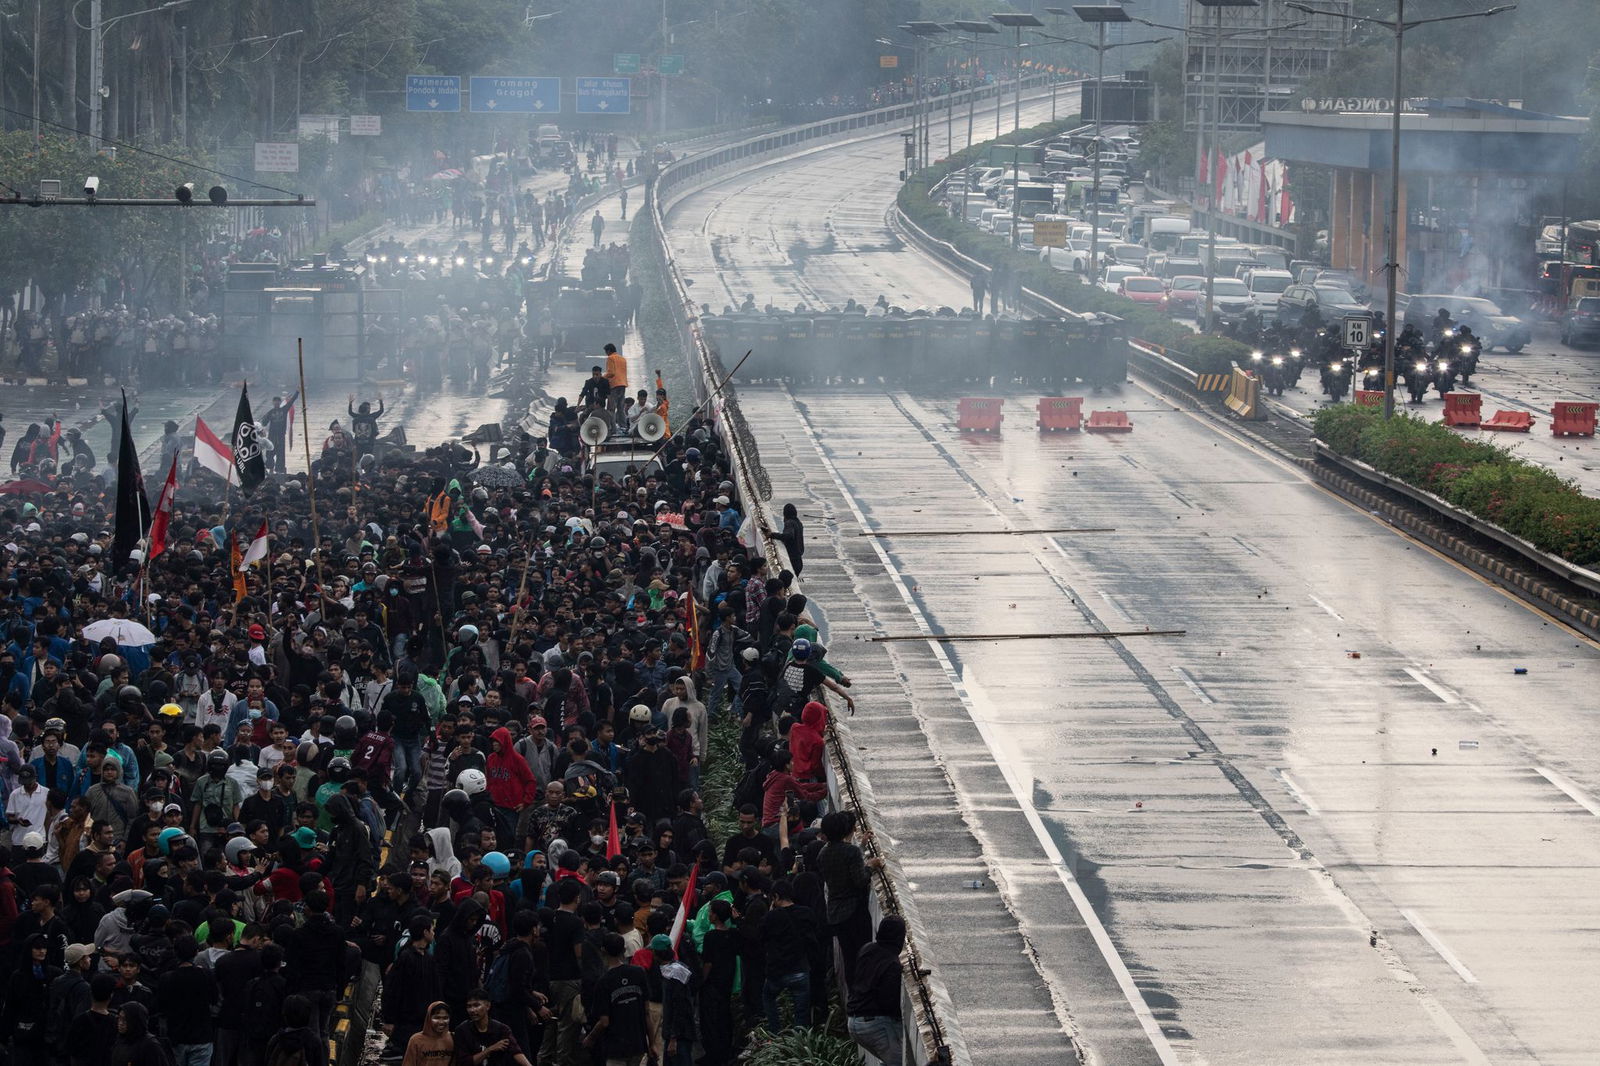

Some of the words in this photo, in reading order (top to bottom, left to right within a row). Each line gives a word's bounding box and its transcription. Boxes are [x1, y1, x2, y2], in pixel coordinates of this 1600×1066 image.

[413, 78, 454, 87] Palmerah
[492, 79, 538, 89] Tomang
[408, 86, 436, 96] Pondok
[438, 86, 459, 97] Indah
[496, 88, 535, 98] Grogol
[1350, 331, 1363, 342] 10
[364, 745, 374, 760] 2
